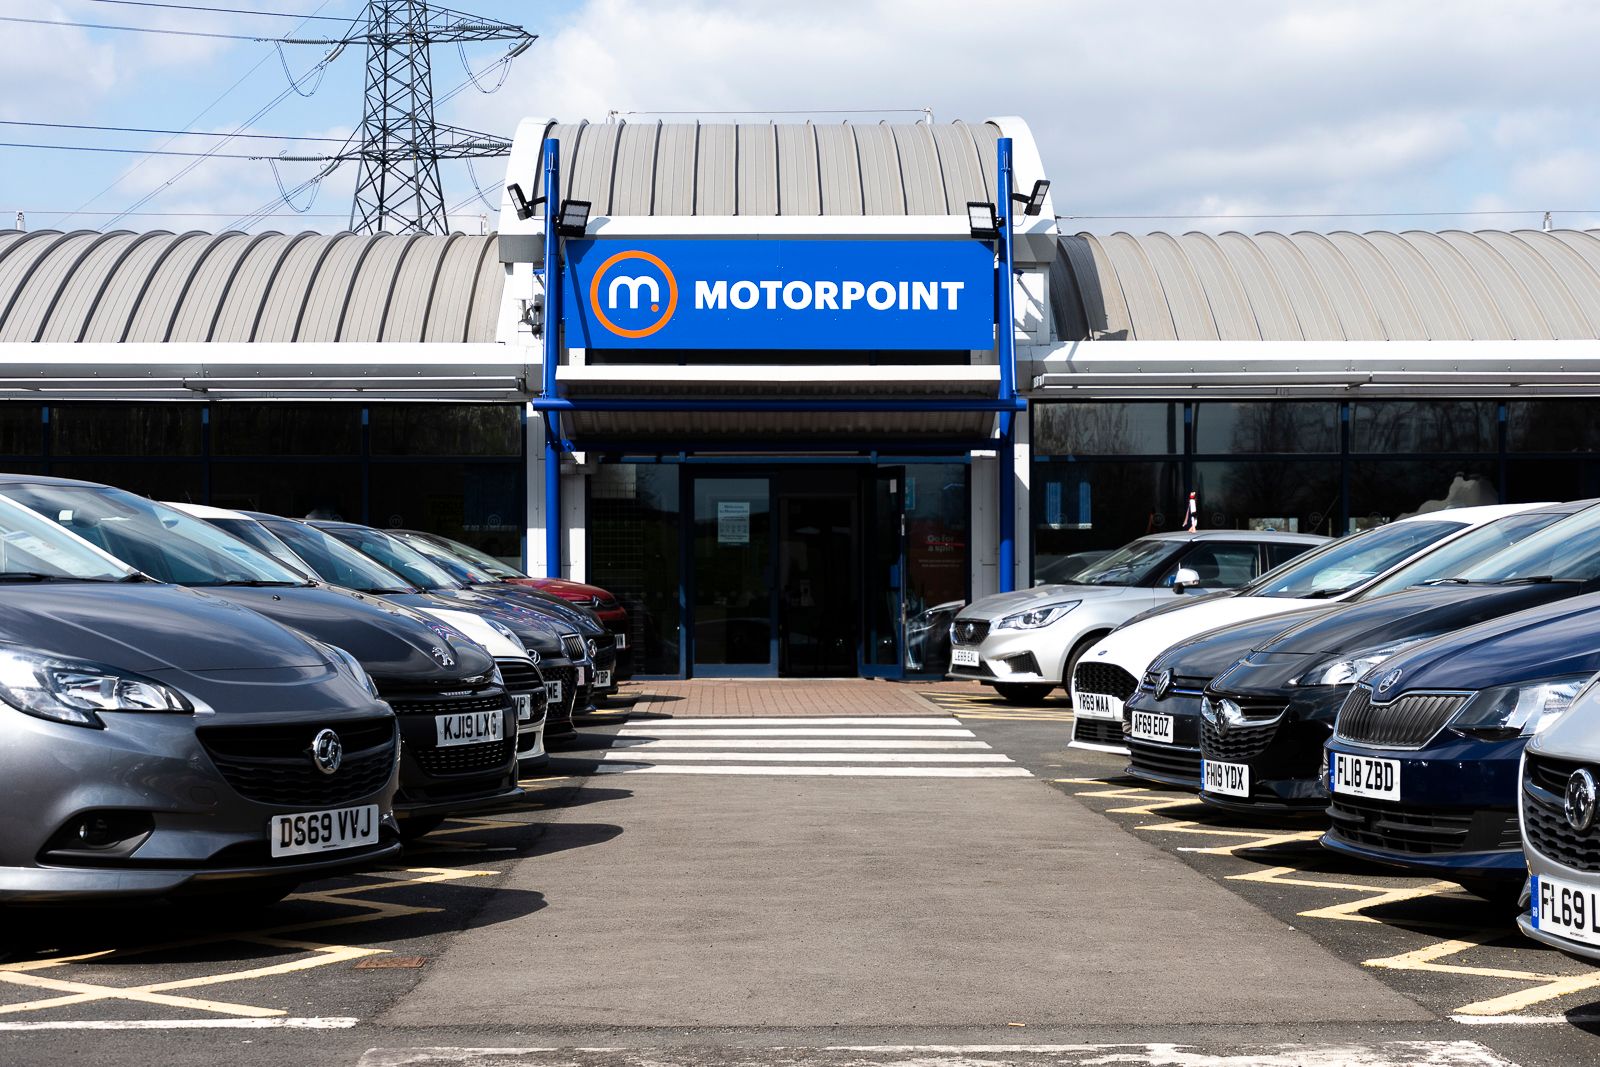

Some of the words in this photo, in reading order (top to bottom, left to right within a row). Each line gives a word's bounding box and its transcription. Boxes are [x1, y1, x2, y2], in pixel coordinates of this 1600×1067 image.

[694, 280, 965, 311] MOTORPOINT
[1078, 693, 1094, 711] YR69
[444, 715, 473, 740] KJ19
[476, 712, 497, 737] LXG
[1134, 713, 1152, 734] AF69
[1153, 716, 1169, 737] EOZ
[1206, 761, 1222, 787] FH19
[1224, 764, 1244, 790] YDX
[1338, 756, 1361, 787] FL18
[1365, 760, 1394, 791] ZBD
[280, 813, 332, 848] DS69
[338, 808, 371, 840] VVJ
[1541, 881, 1585, 930] FL69
